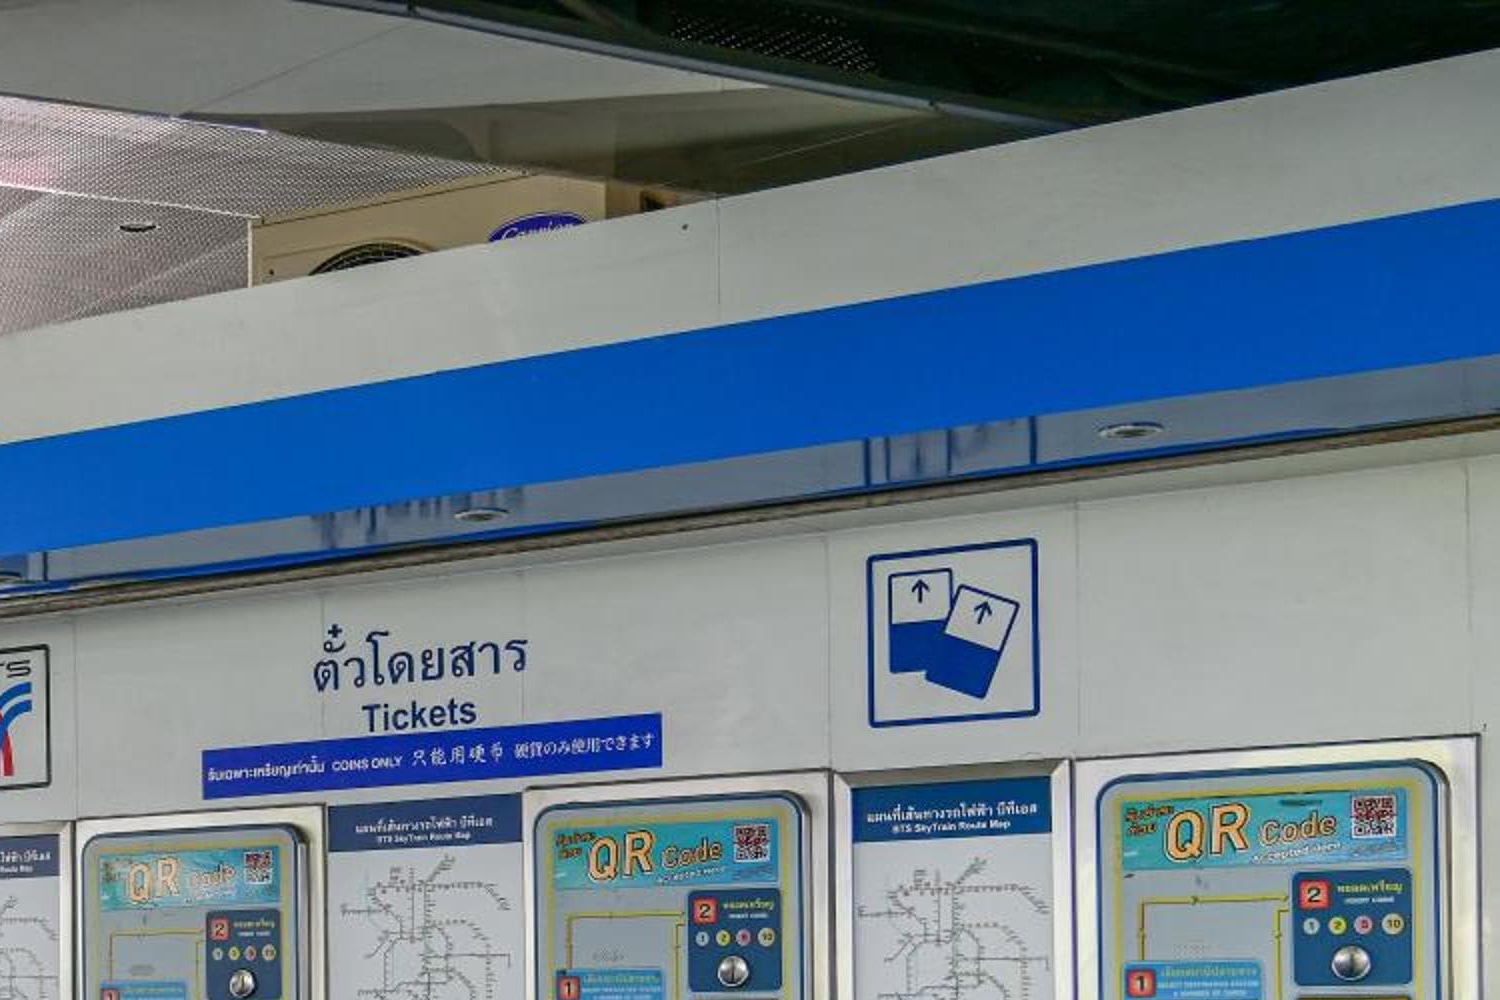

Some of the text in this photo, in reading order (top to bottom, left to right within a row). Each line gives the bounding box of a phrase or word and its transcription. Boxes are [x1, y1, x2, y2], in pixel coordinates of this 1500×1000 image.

[312, 624, 528, 694] ตั๋วโดยสาร
[362, 698, 477, 733] Tickets
[332, 757, 369, 772] COINS
[372, 755, 404, 769] ONLY
[1164, 801, 1250, 863] QR
[1258, 809, 1338, 847] Code
[587, 829, 657, 883] QR
[661, 836, 722, 869] Code
[128, 855, 181, 904] QR
[1307, 887, 1321, 903] 2
[698, 902, 712, 919] 2
[213, 922, 226, 937] 2
[1387, 919, 1401, 929] 10
[563, 981, 573, 997] 1
[1136, 975, 1146, 993] 1
